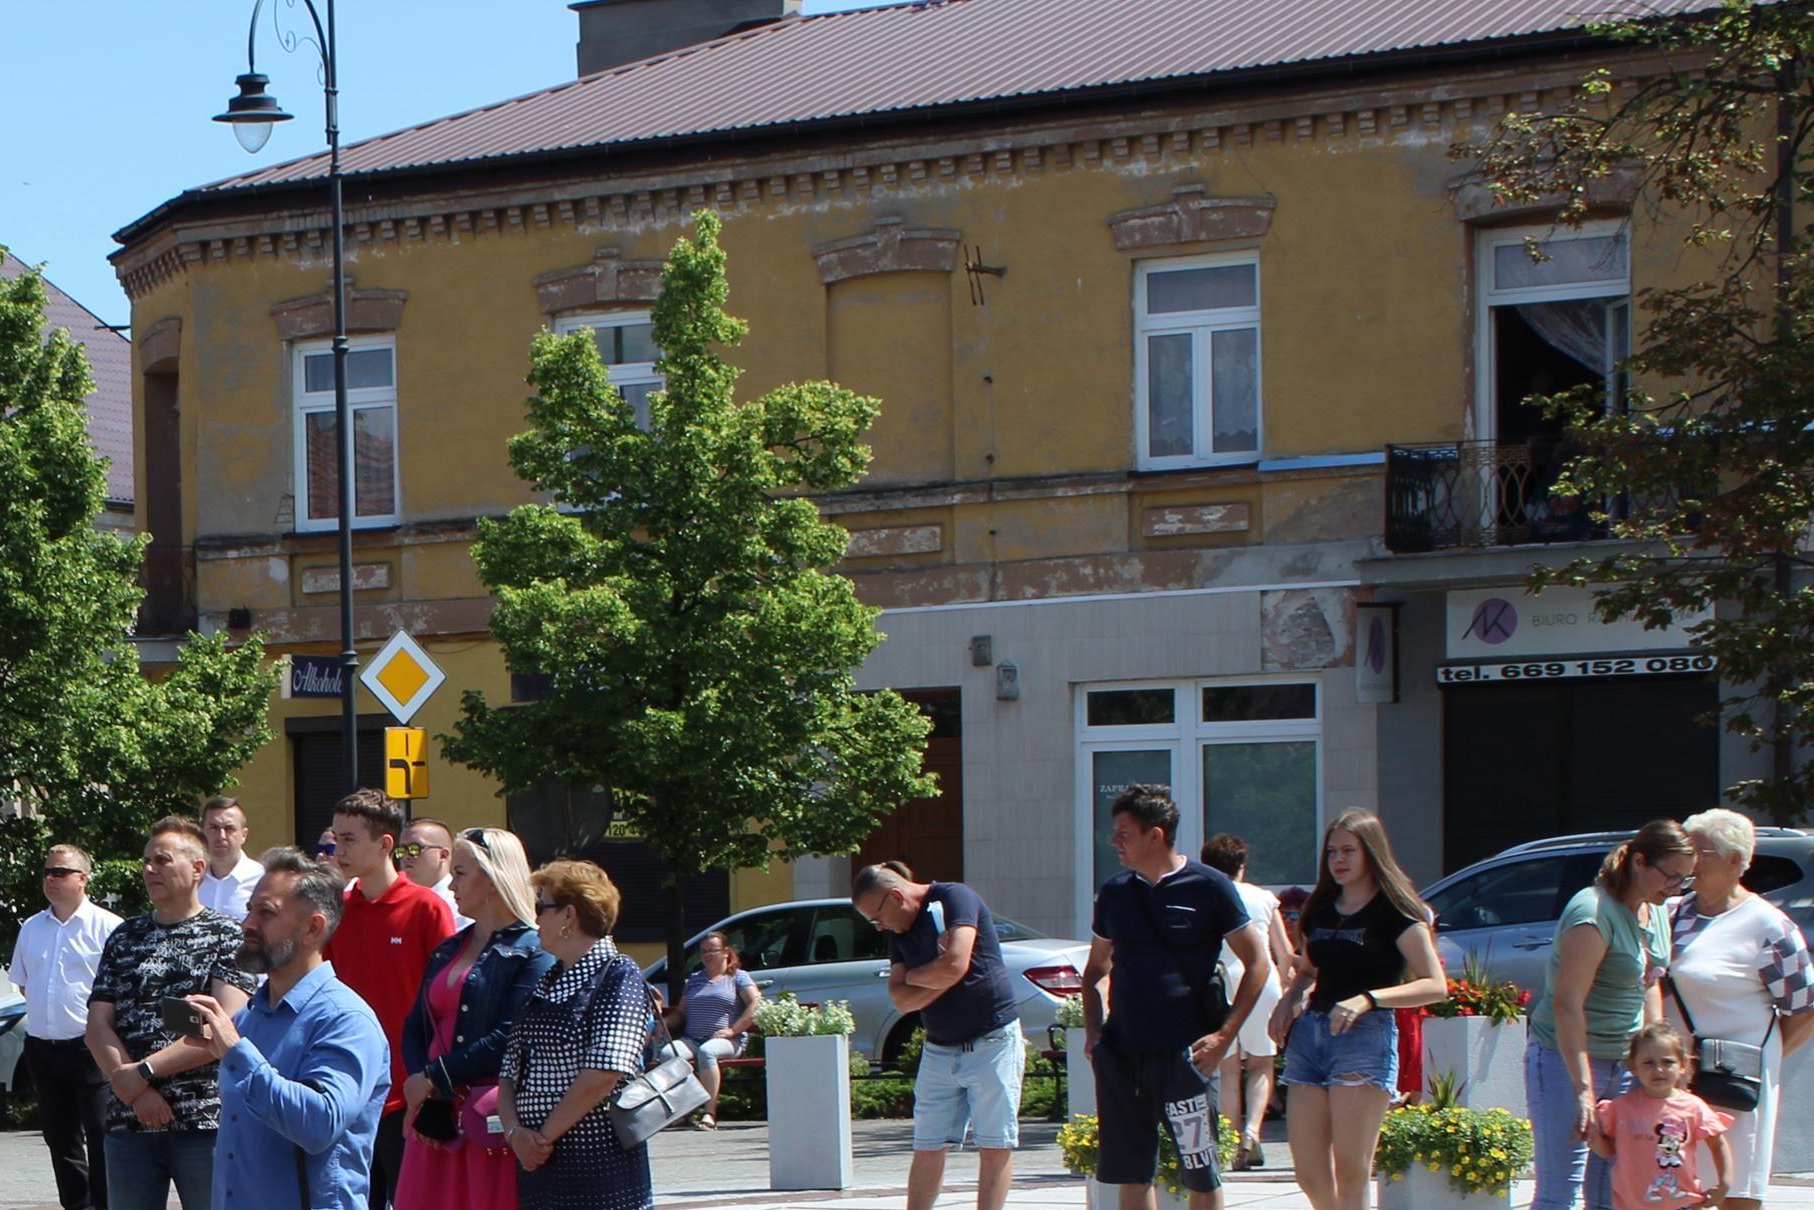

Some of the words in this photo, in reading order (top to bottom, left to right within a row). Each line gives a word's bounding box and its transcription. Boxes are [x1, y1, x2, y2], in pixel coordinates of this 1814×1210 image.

[1532, 613, 1577, 627] BIURO
[293, 662, 342, 693] Alkohol
[1441, 667, 1490, 681] tel.
[1500, 664, 1565, 680] 669
[1576, 658, 1635, 675] 152
[1646, 655, 1713, 673] 080
